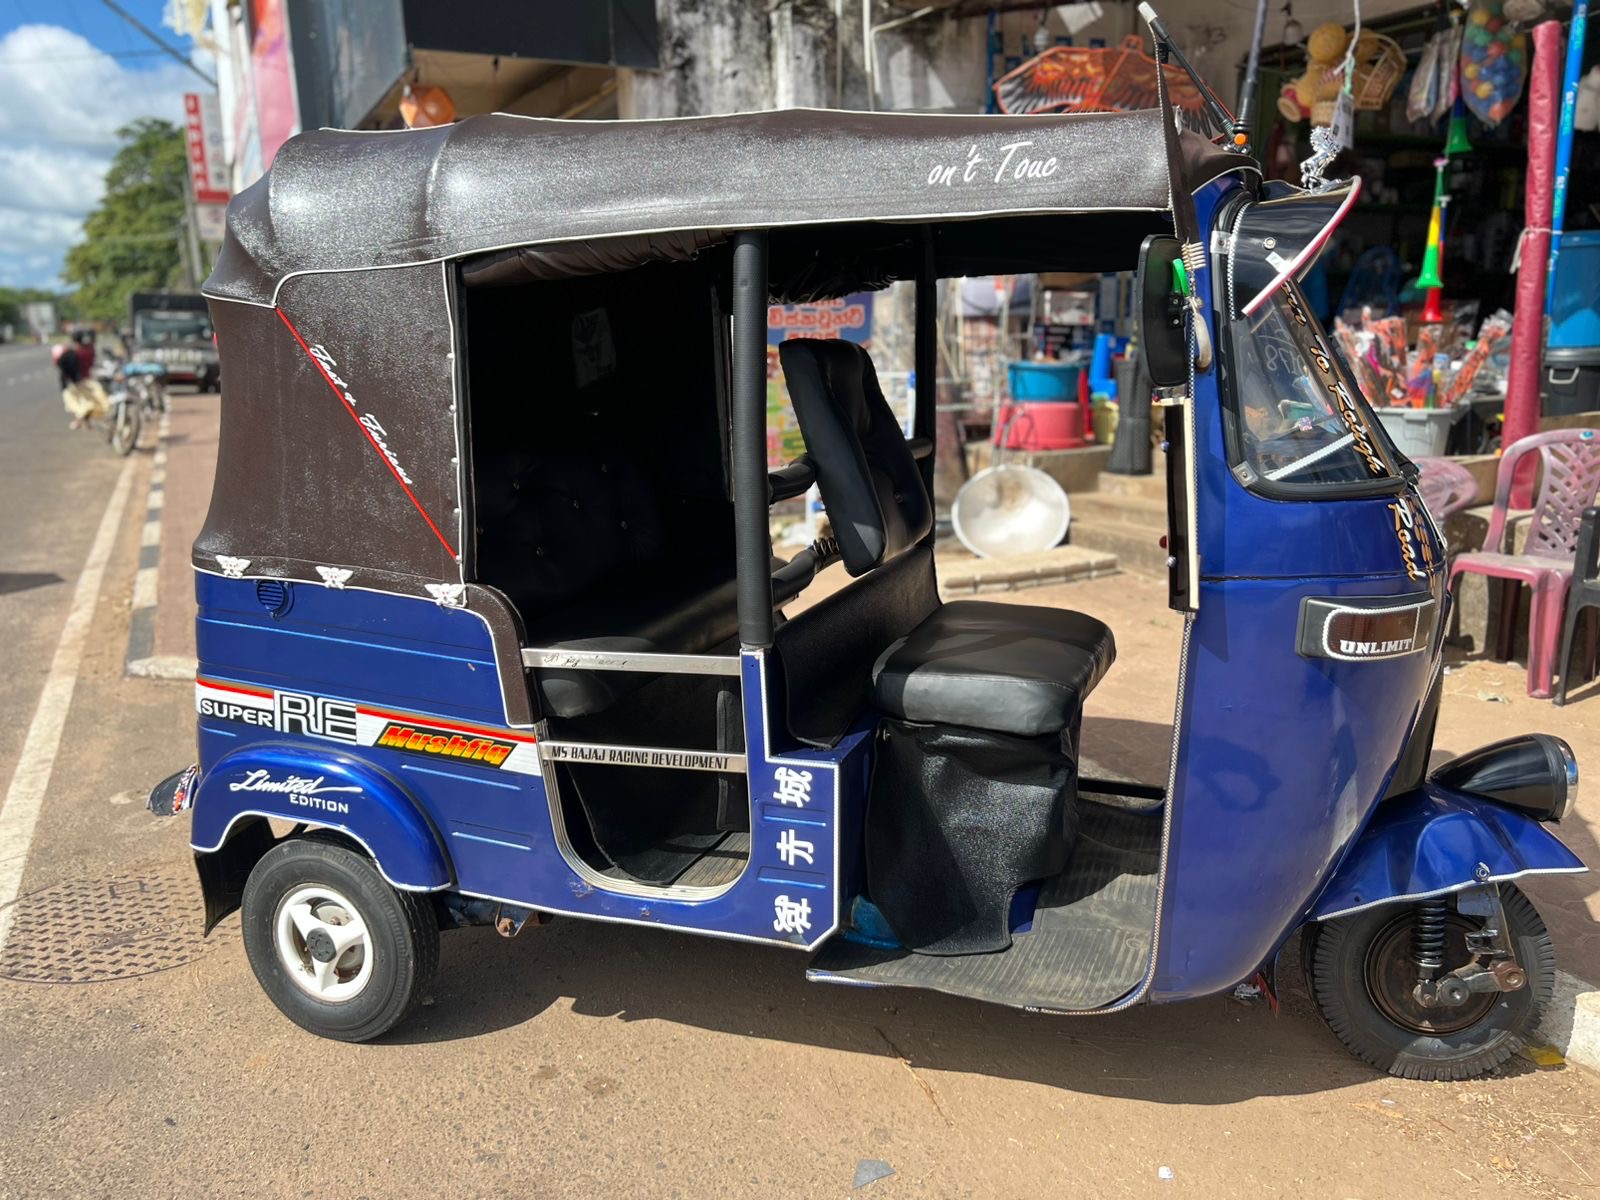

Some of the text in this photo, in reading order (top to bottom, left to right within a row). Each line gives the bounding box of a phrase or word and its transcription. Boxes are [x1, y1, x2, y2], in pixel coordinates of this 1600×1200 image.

[994, 141, 1057, 183] Touc
[310, 344, 348, 389] Fast
[359, 413, 413, 485] Furious
[1310, 333, 1330, 374] To
[1327, 380, 1387, 475] Rough
[1387, 497, 1427, 581] Road
[201, 690, 356, 746] SUPER RE
[377, 725, 513, 766] Mushfiq
[571, 747, 606, 761] BAJAJ
[609, 750, 649, 765] RACING
[651, 753, 731, 770] DEVELOPMENT
[229, 769, 363, 795] Limited
[289, 793, 350, 814] EDITION
